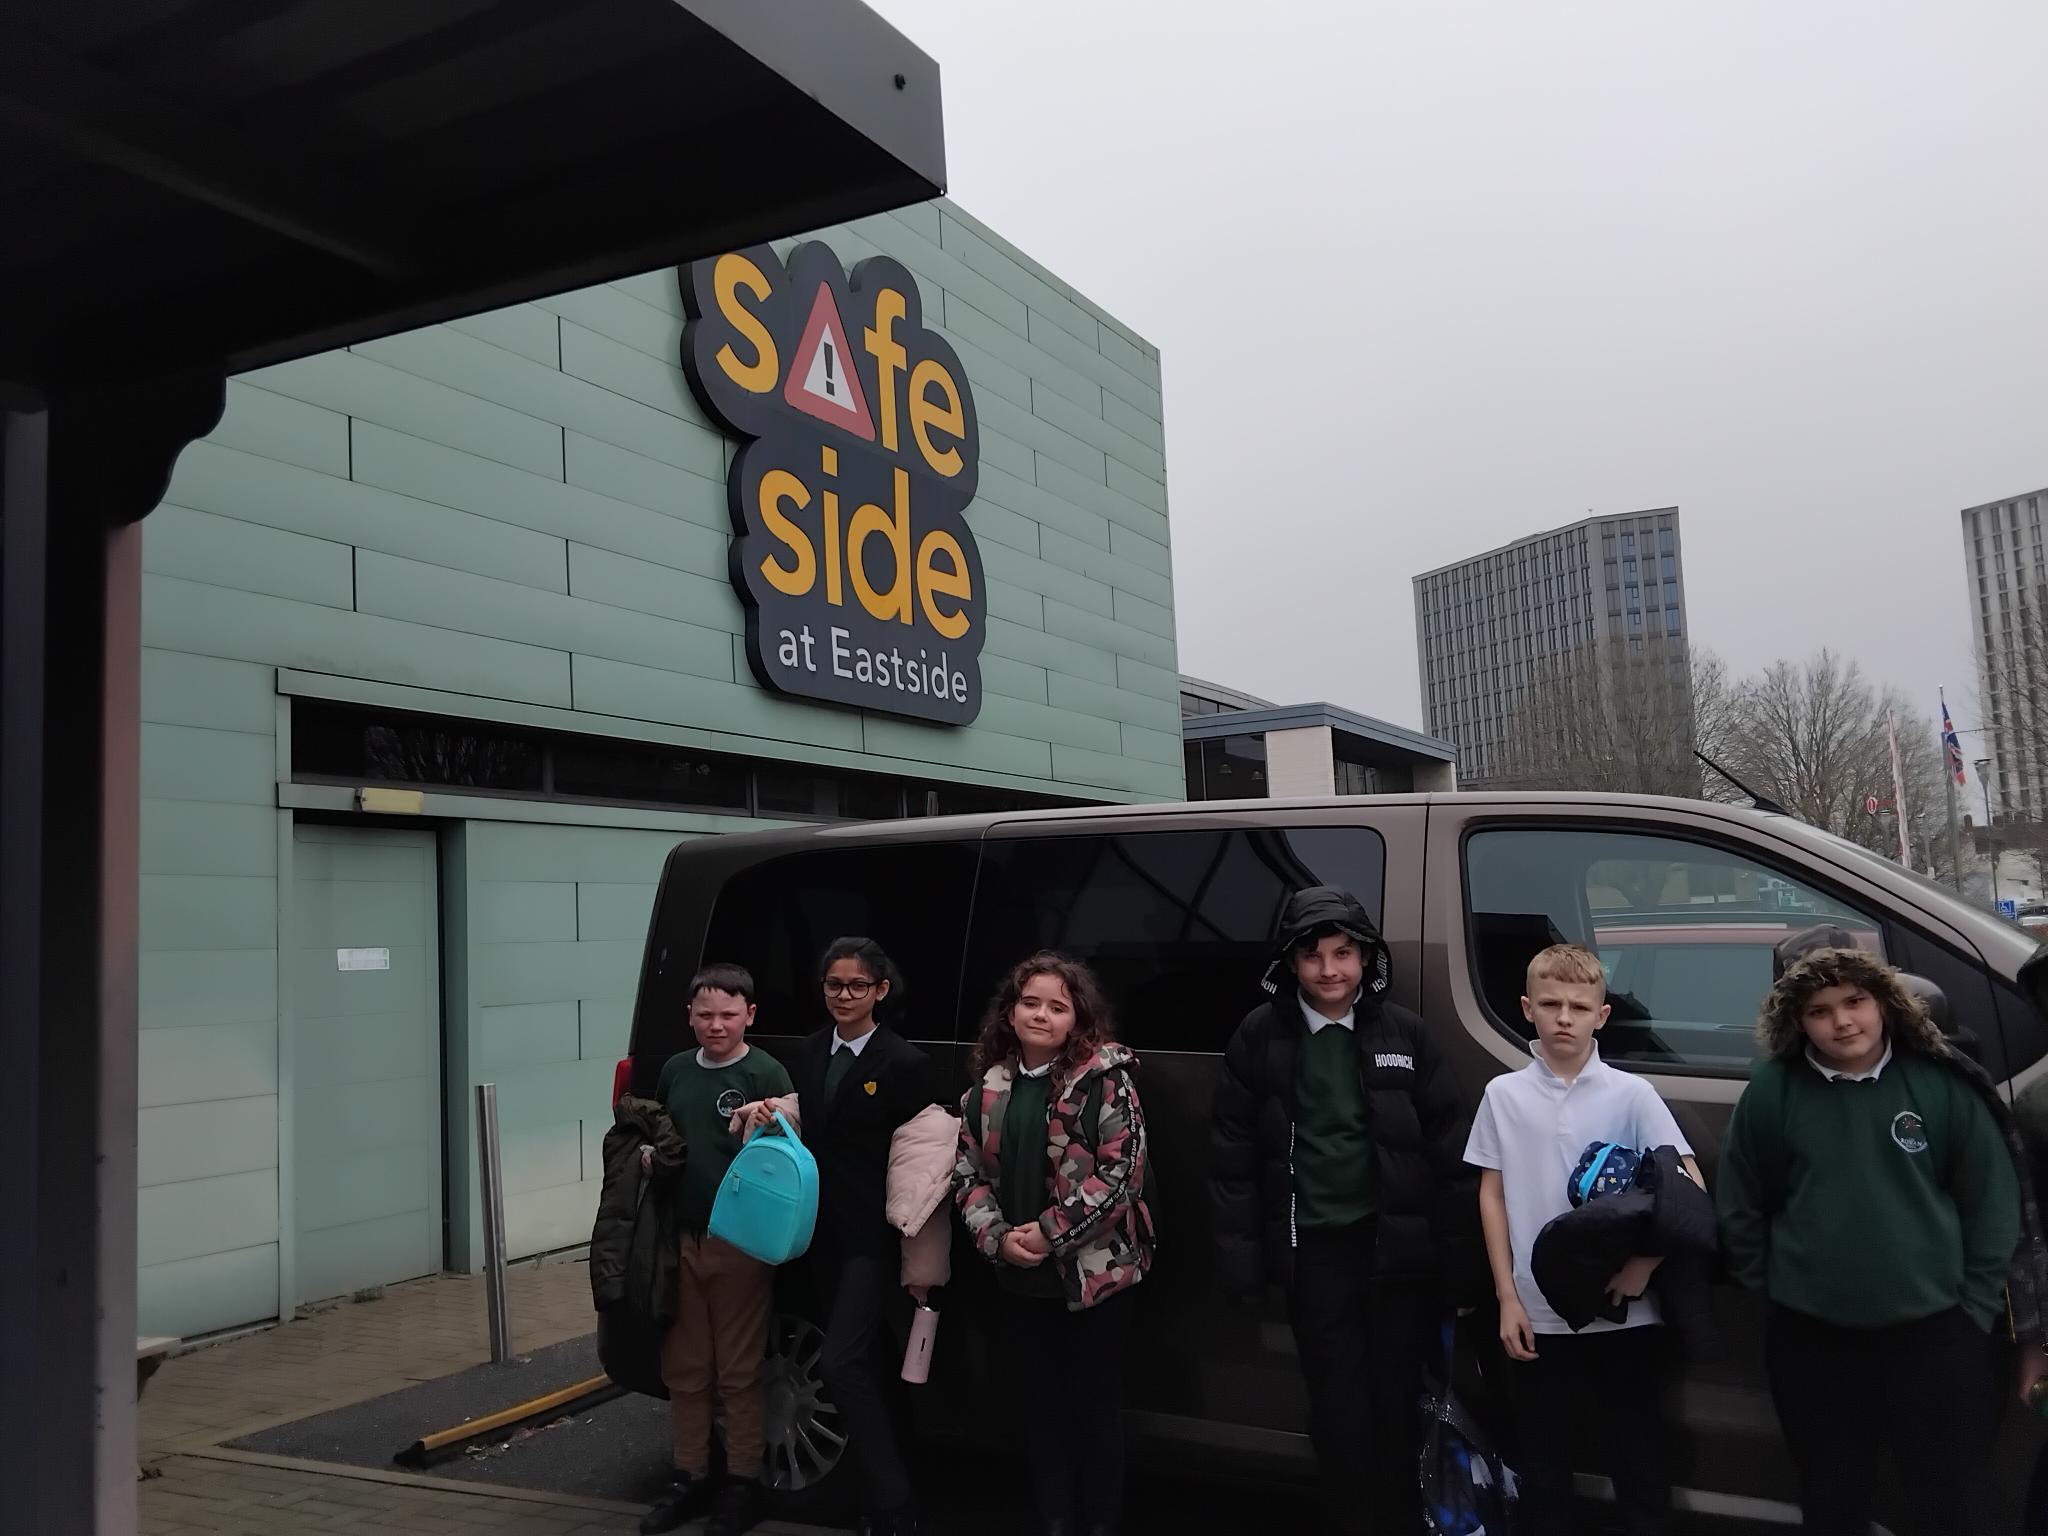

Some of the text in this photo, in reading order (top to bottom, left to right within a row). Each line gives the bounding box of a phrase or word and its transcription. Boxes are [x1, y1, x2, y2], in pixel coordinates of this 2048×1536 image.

[759, 445, 972, 639] side
[779, 625, 968, 703] at Eastside
